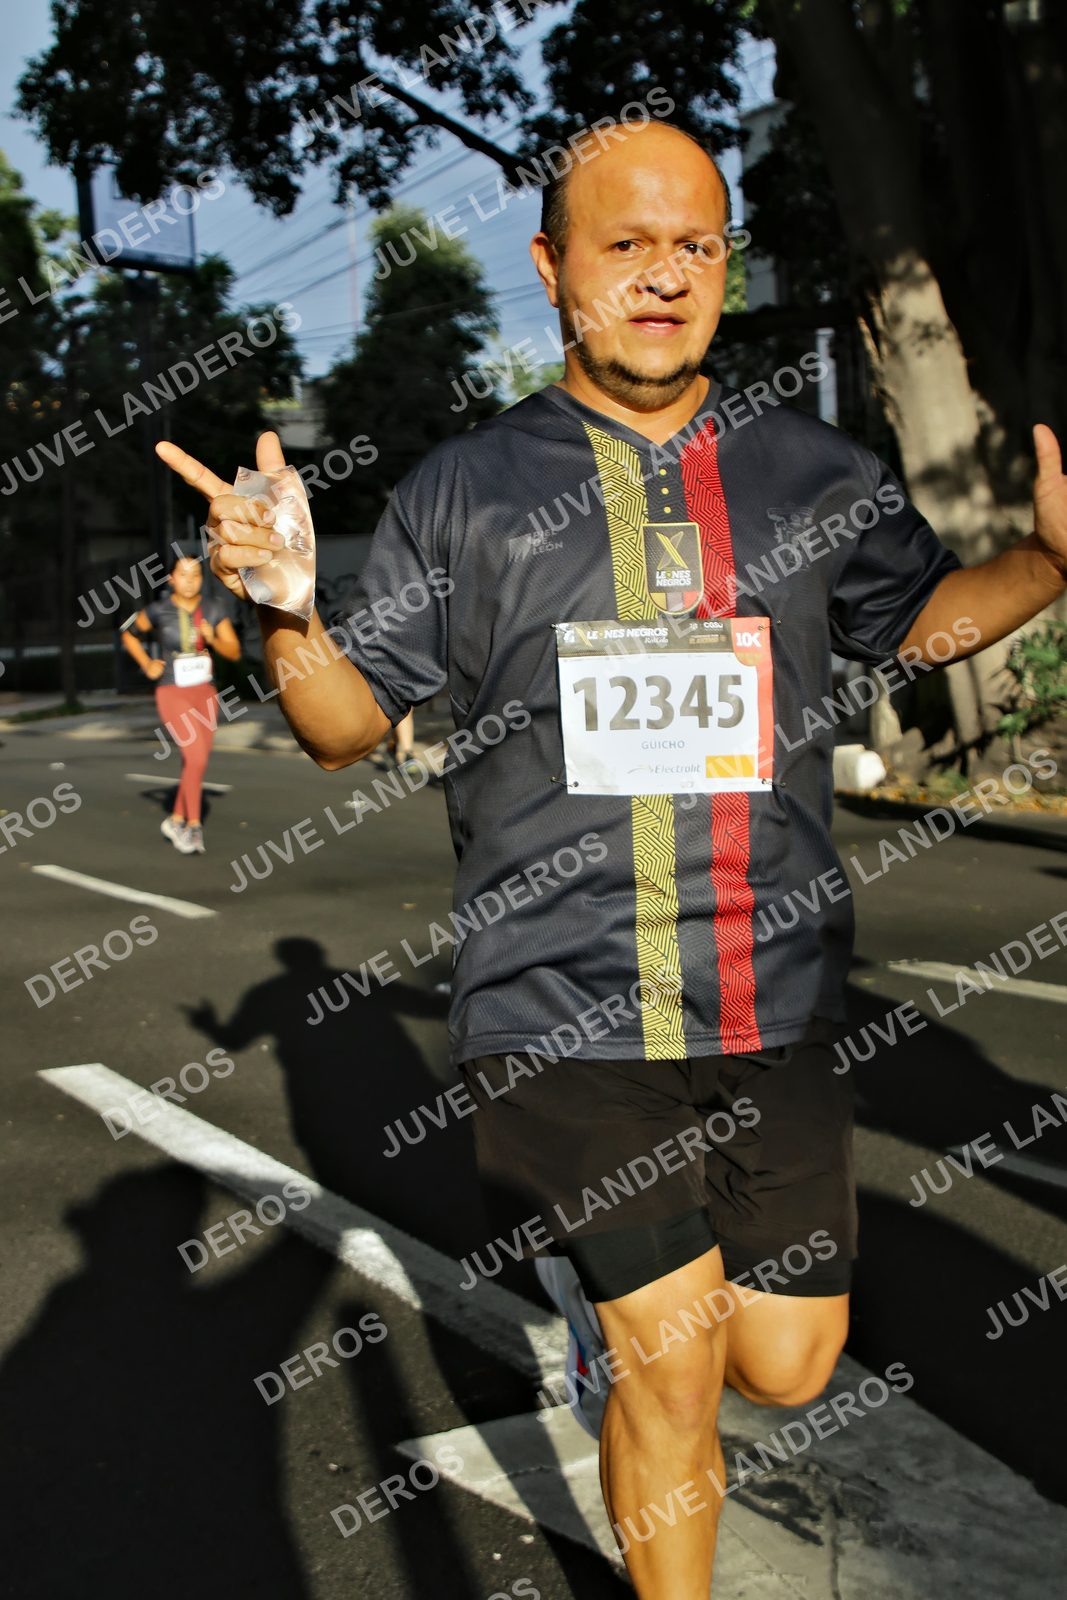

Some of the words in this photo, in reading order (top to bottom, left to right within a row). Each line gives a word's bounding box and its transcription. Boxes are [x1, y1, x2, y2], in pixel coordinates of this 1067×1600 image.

[656, 578, 692, 587] NEGROS
[626, 627, 669, 639] NEGROS
[735, 632, 762, 647] 10K
[573, 675, 744, 731] 12345
[641, 740, 685, 750] GUICHO
